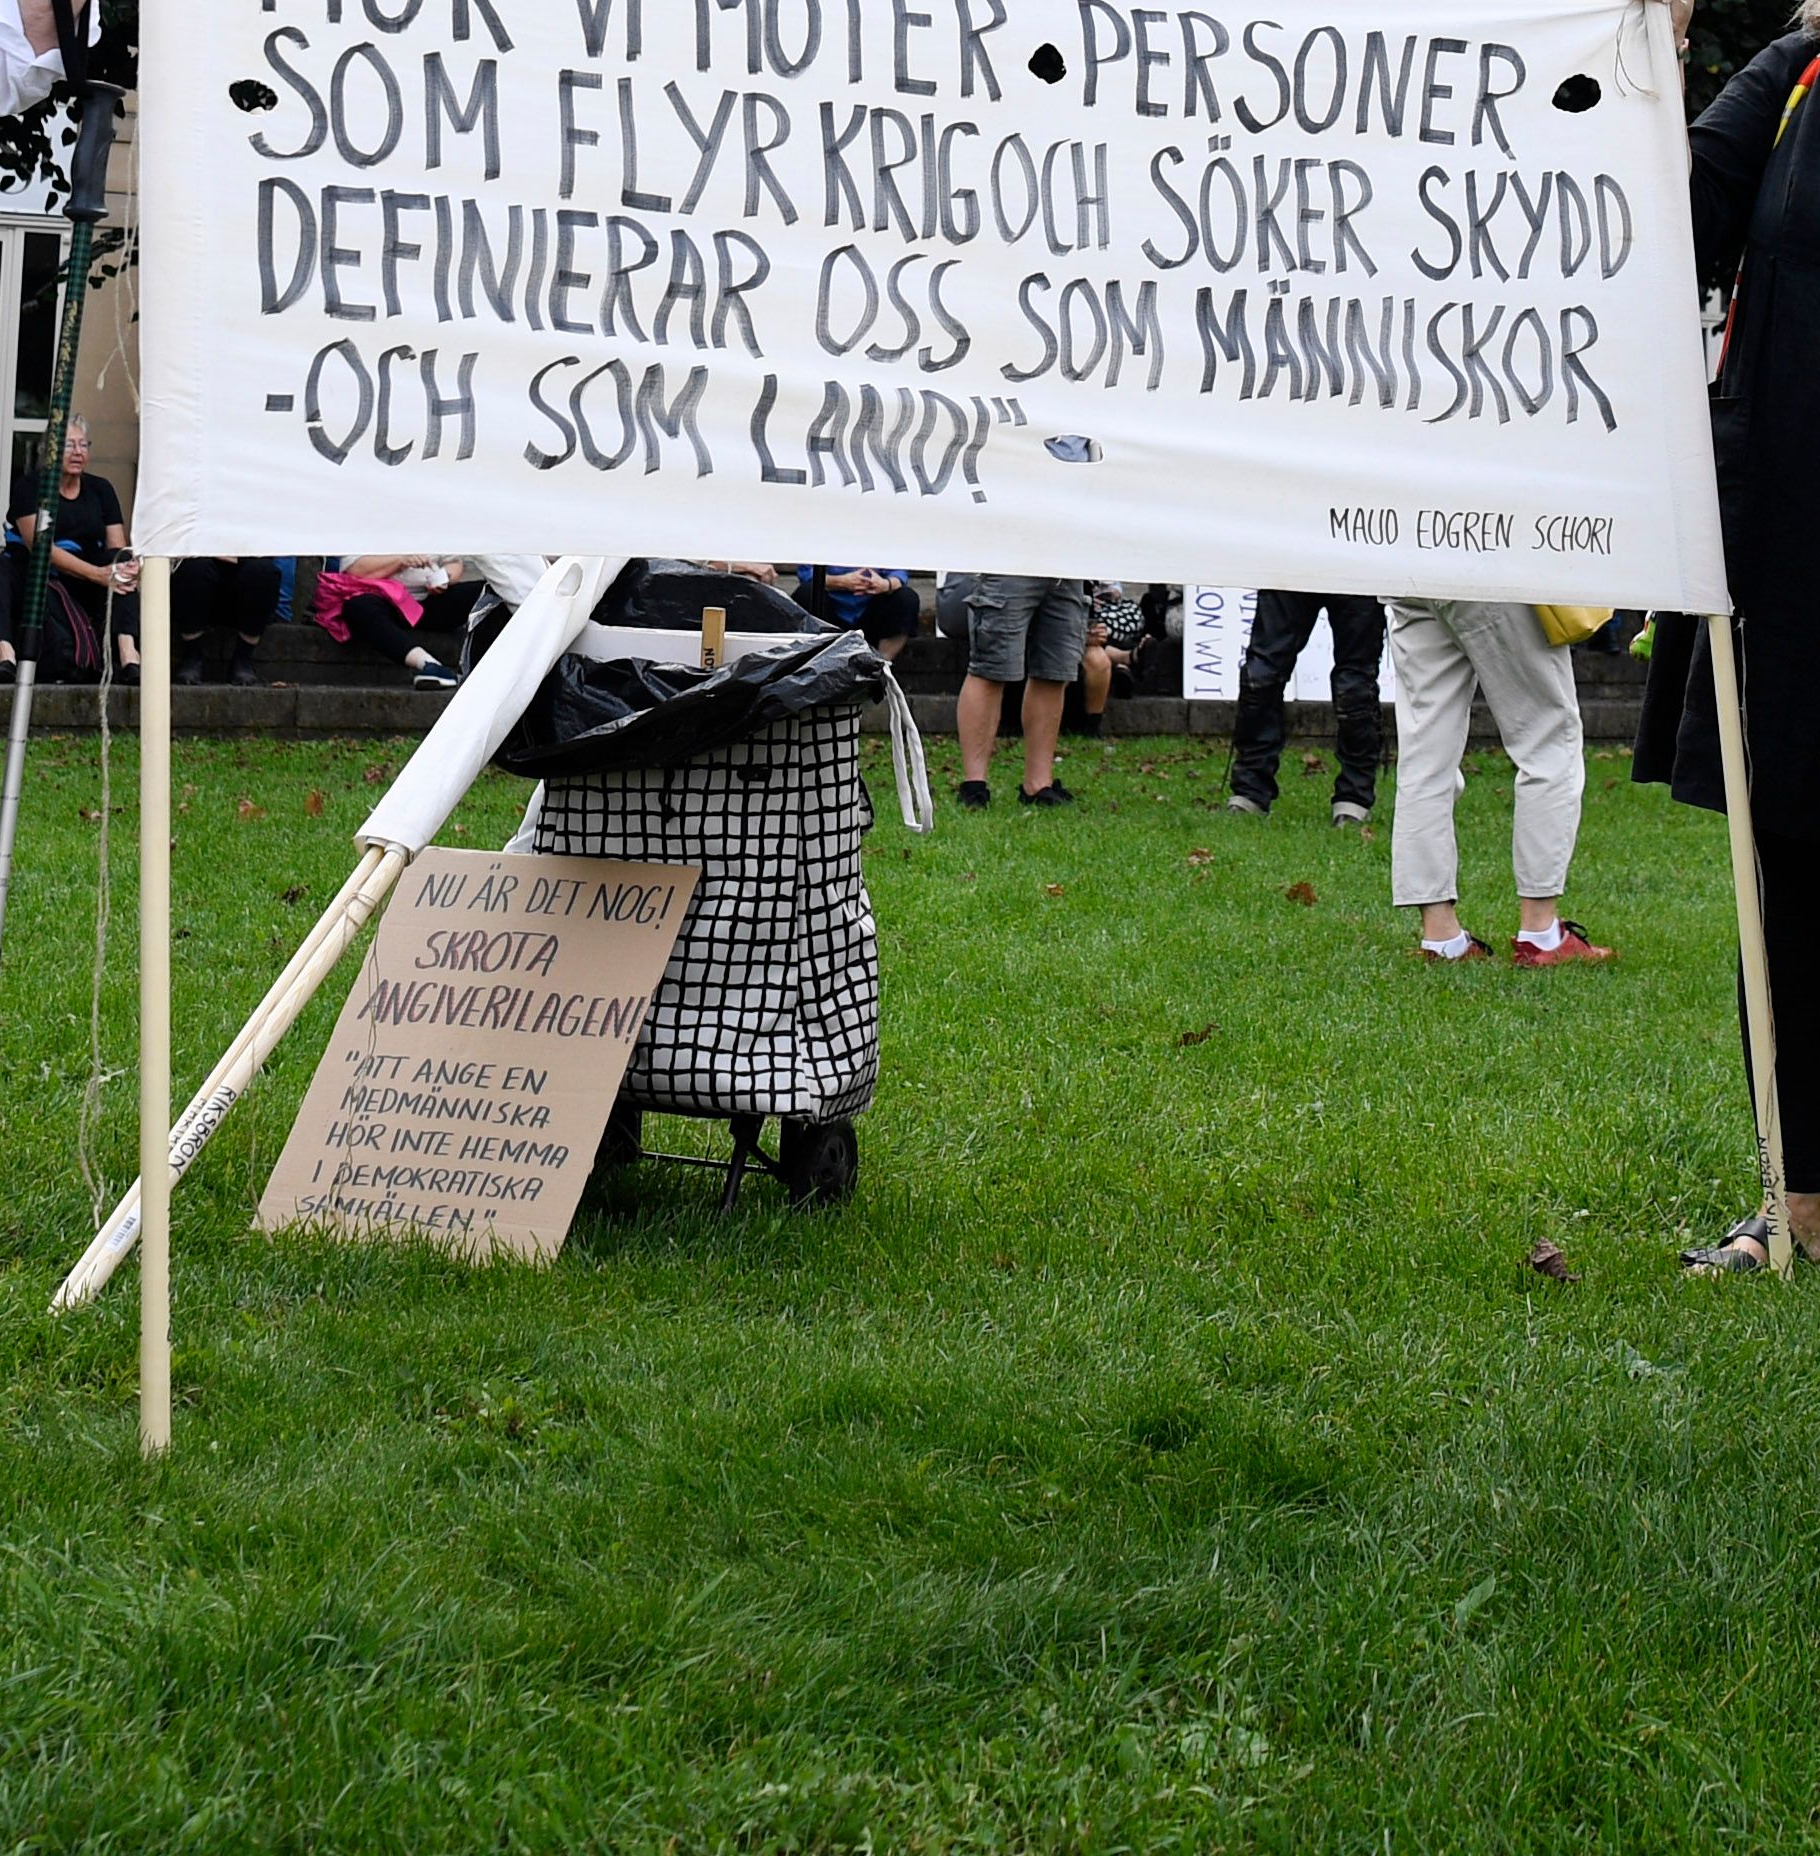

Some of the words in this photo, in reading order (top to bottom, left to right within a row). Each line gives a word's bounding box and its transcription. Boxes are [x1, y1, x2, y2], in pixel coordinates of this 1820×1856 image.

[248, 25, 501, 182] SOM
[559, 68, 799, 226] FLYR
[819, 101, 981, 245] KRIG
[990, 131, 1111, 257] OCH
[1141, 134, 1379, 279] SÖKER
[1410, 164, 1634, 283] SKYDD
[257, 176, 771, 359] DEFINIERAR
[815, 243, 972, 373] OSS
[999, 271, 1165, 391] SOM
[1195, 278, 1618, 434] MÄNNISKOR
[522, 355, 714, 480] SOM
[1329, 507, 1399, 546] MAUD
[1416, 509, 1515, 554] EDGREN
[1530, 514, 1614, 555] SCHORI
[1193, 638, 1223, 677] AM
[415, 872, 468, 909] NU
[467, 862, 519, 913] ÄR
[525, 876, 588, 916] DET
[586, 882, 676, 930] NOG!
[414, 929, 560, 977] SKROTA
[356, 978, 648, 1044] ANGIVERILAGEN!
[411, 1057, 497, 1089] ANGE
[501, 1066, 548, 1096] EN
[340, 1084, 551, 1129] MEDMÄNNISKA
[325, 1114, 387, 1152] HÖR
[390, 1127, 455, 1157] INTE
[458, 1134, 570, 1170] HEMMA
[311, 1159, 323, 1184] I
[331, 1161, 545, 1202] DEMOKRATISKA
